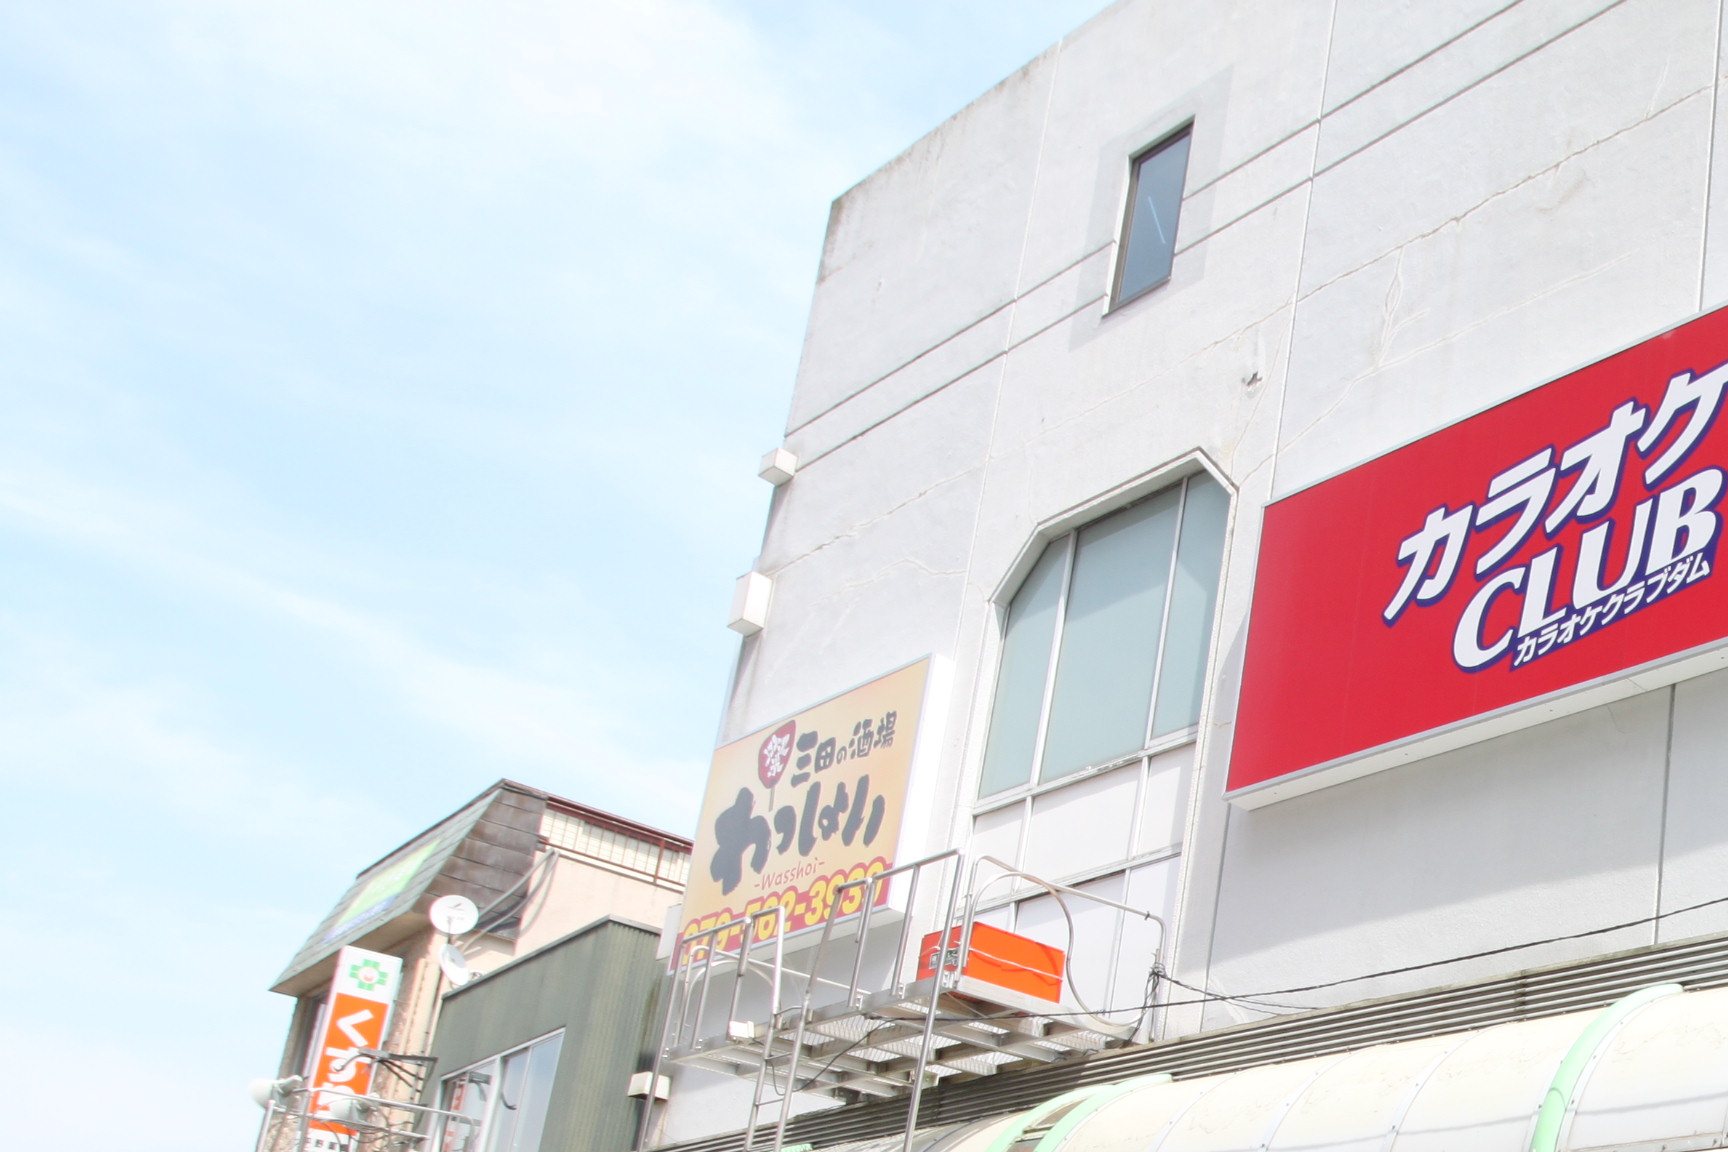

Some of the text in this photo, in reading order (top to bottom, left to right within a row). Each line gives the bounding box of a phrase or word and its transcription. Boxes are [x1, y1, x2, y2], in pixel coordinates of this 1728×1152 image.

[1454, 468, 1723, 668] CLUB
[1514, 552, 1711, 667] カラオケクラブダム
[790, 710, 897, 788] 三田の酒場
[709, 775, 886, 896] わっしょい
